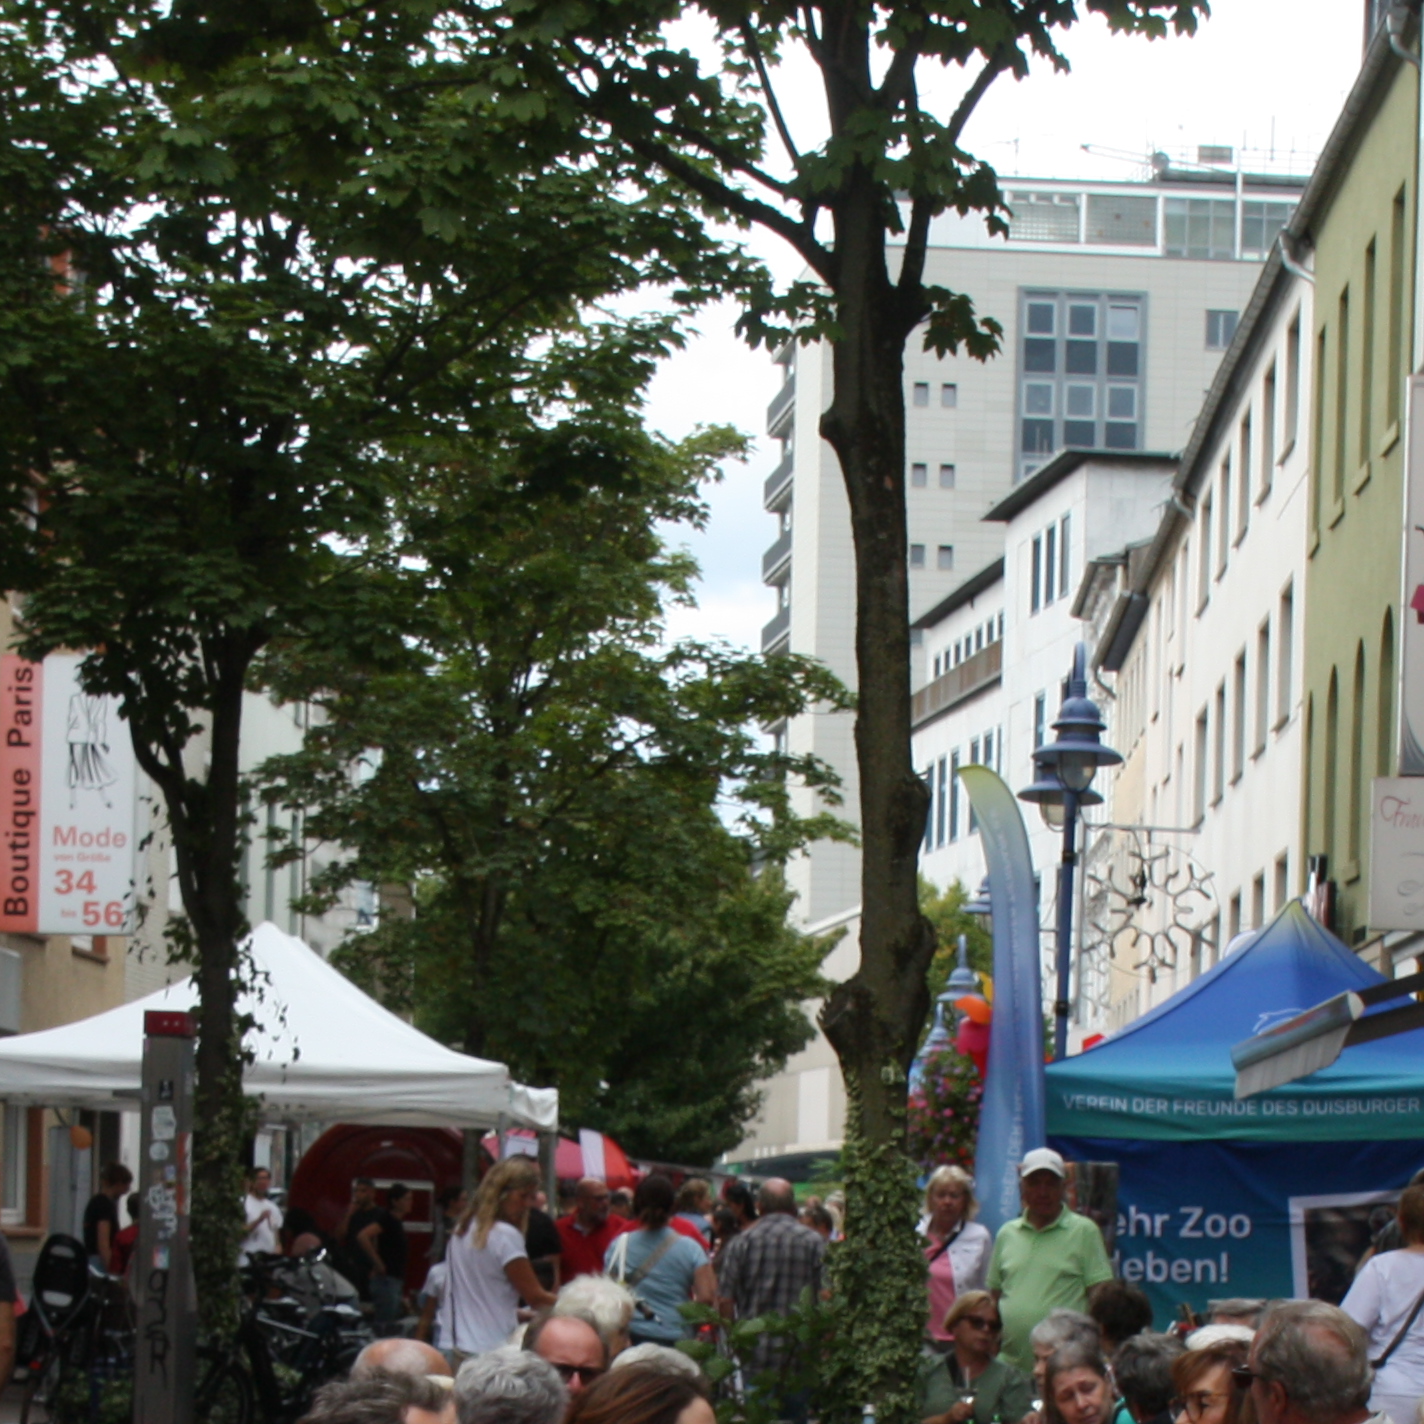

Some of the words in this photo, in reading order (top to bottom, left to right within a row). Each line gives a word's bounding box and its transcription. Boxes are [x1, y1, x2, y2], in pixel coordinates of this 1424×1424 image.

[7, 665, 34, 748] Paris
[3, 768, 36, 917] Boutique
[53, 826, 127, 848] Mode
[54, 869, 97, 895] 34
[82, 901, 124, 927] 56
[1062, 1093, 1128, 1113] VEREIN
[1133, 1096, 1169, 1114] DER
[1173, 1097, 1258, 1116] FREUNDE
[1262, 1098, 1299, 1116] DES
[1302, 1096, 1421, 1116] DUISBURGER
[1116, 1204, 1171, 1238] ehr
[1178, 1205, 1252, 1239] Zoo
[1111, 1250, 1229, 1284] leben!
